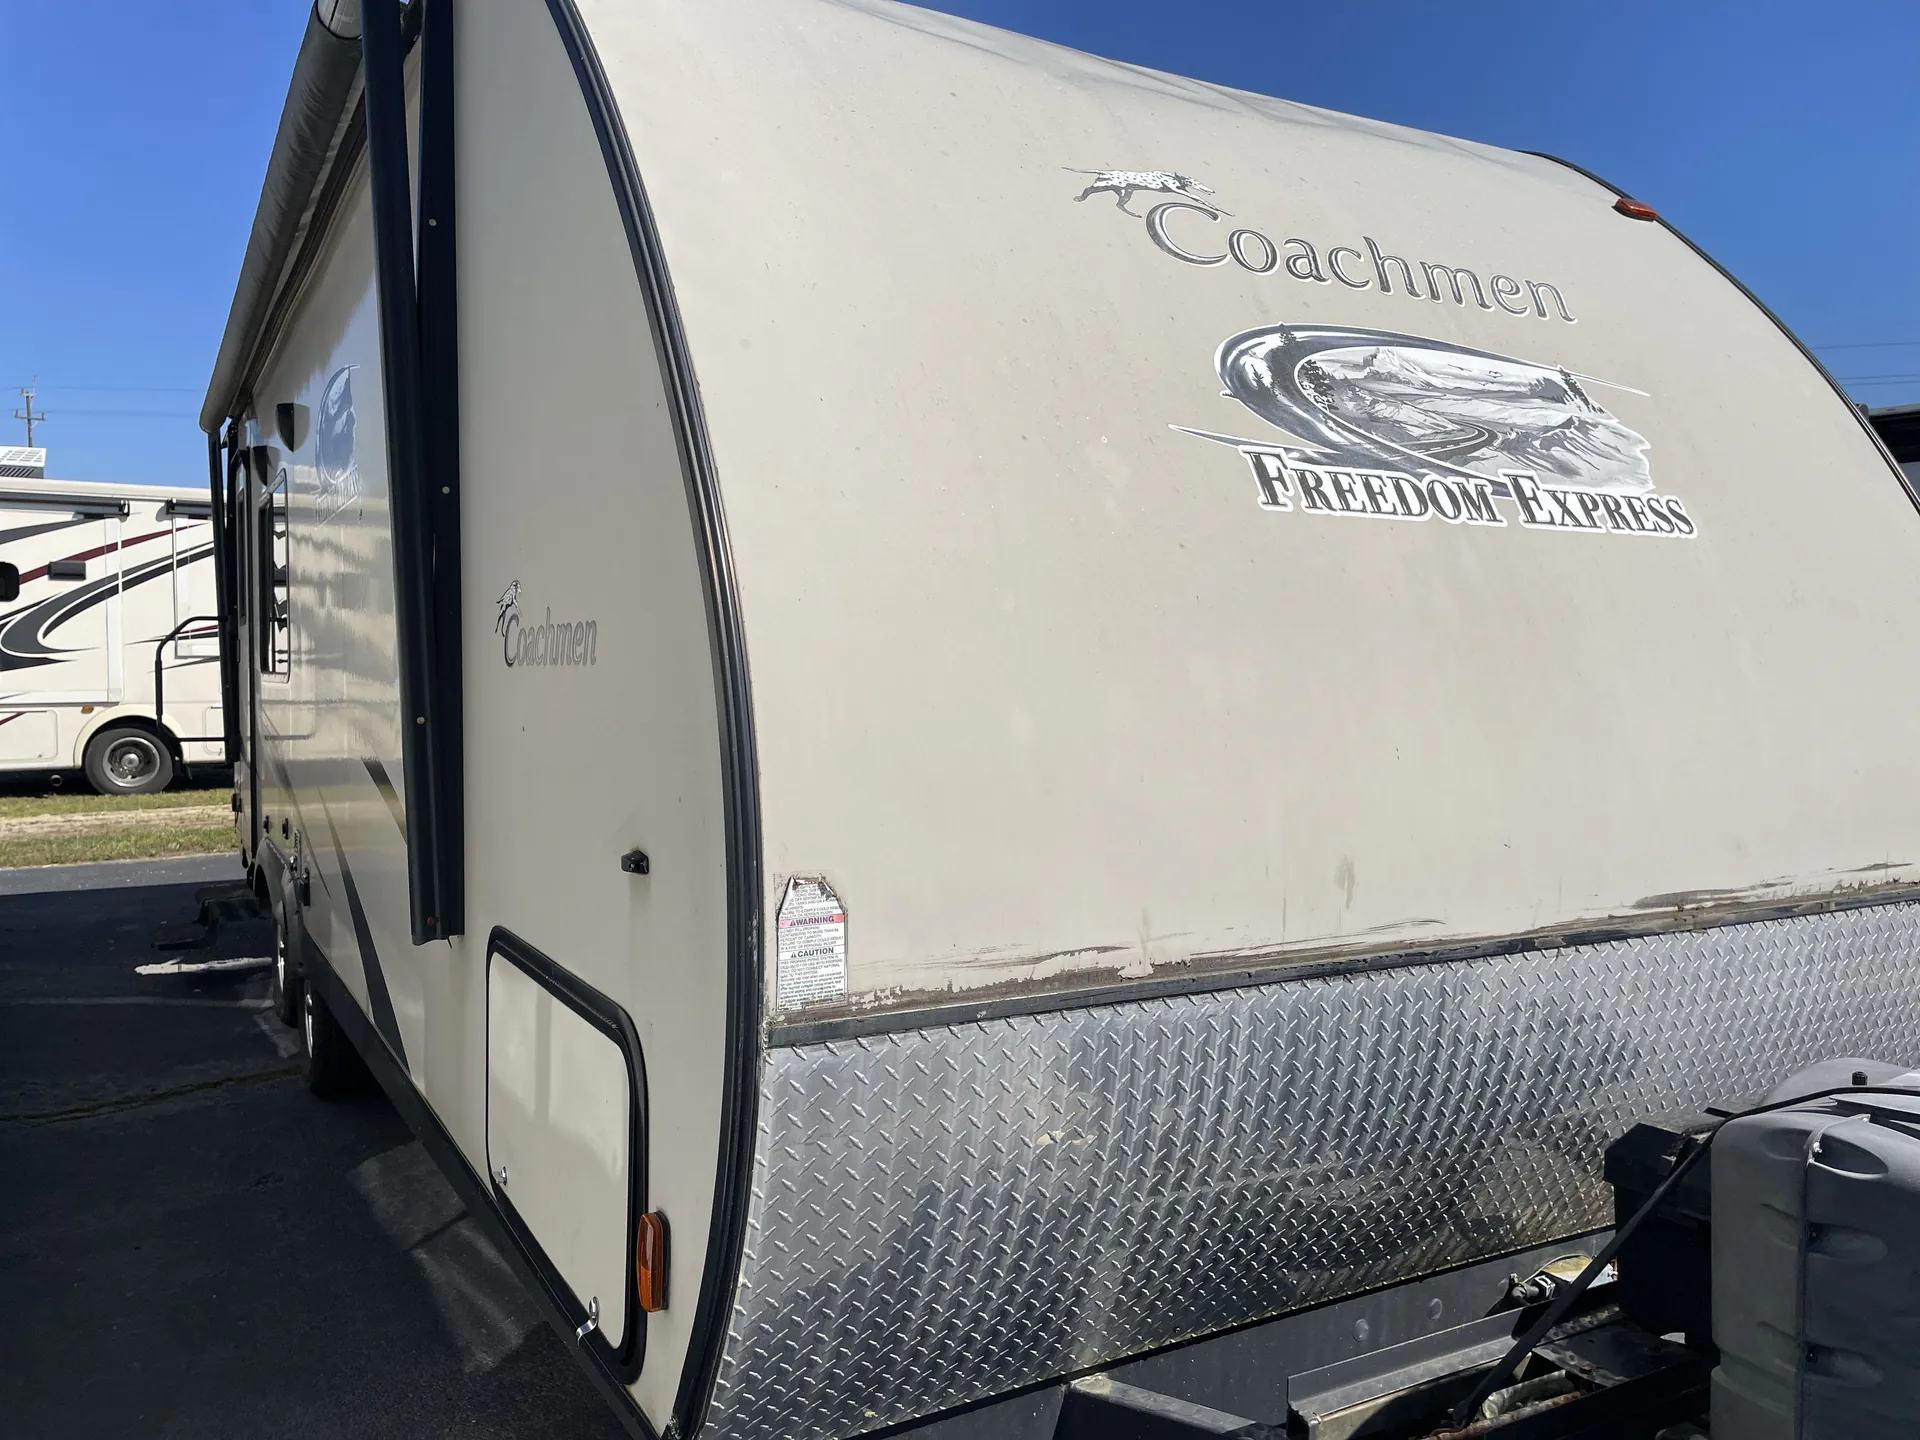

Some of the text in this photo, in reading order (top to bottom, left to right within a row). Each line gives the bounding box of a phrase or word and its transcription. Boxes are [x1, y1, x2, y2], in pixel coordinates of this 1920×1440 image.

[1145, 201, 1578, 324] Coachmen
[1241, 449, 1698, 539] FREEDOM EXPRESS
[504, 606, 597, 667] Coachmen
[796, 916, 834, 926] WARNING
[798, 947, 834, 957] CAUTION
